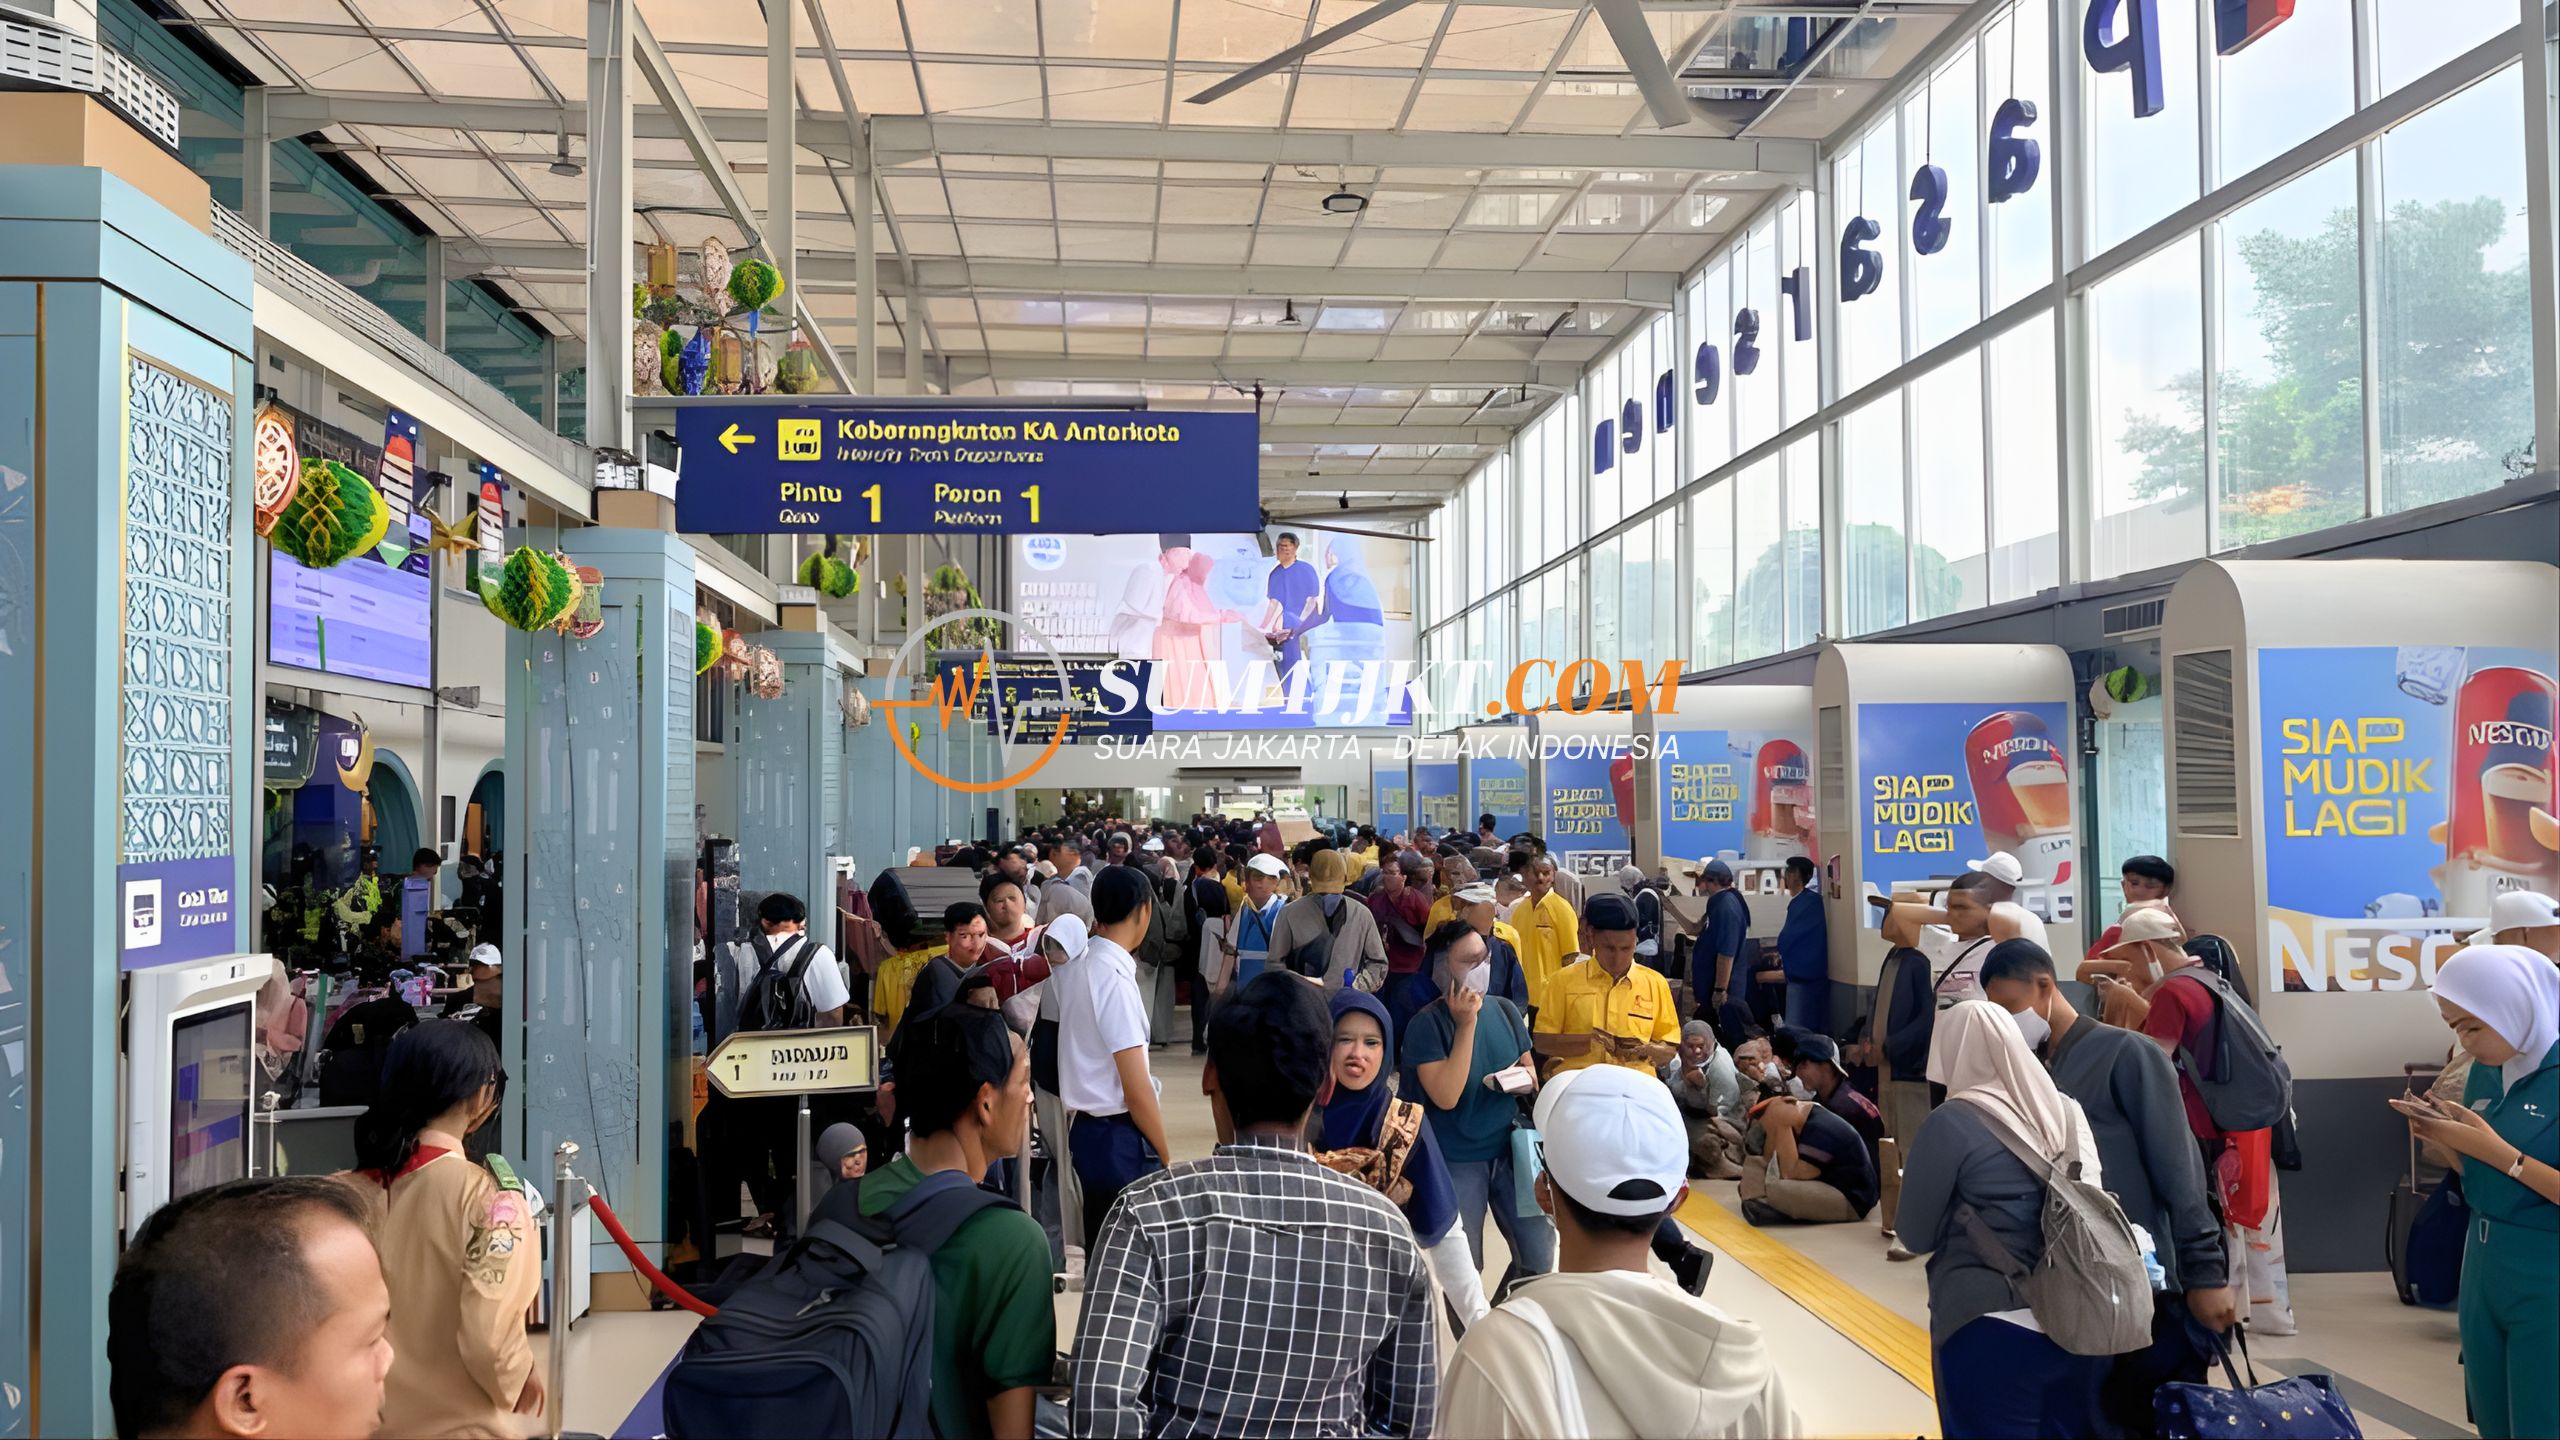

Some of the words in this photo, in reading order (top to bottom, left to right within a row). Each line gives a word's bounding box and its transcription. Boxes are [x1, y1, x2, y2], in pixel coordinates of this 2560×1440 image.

[780, 482, 842, 502] Pintu
[860, 484, 881, 523] 1
[1020, 485, 1040, 523] 1
[2281, 717, 2406, 755] SIAP
[1873, 774, 1955, 801] SIAP
[2282, 757, 2434, 797] MUDIK
[2284, 798, 2407, 838] LAGI
[1873, 828, 1956, 853] LAGI
